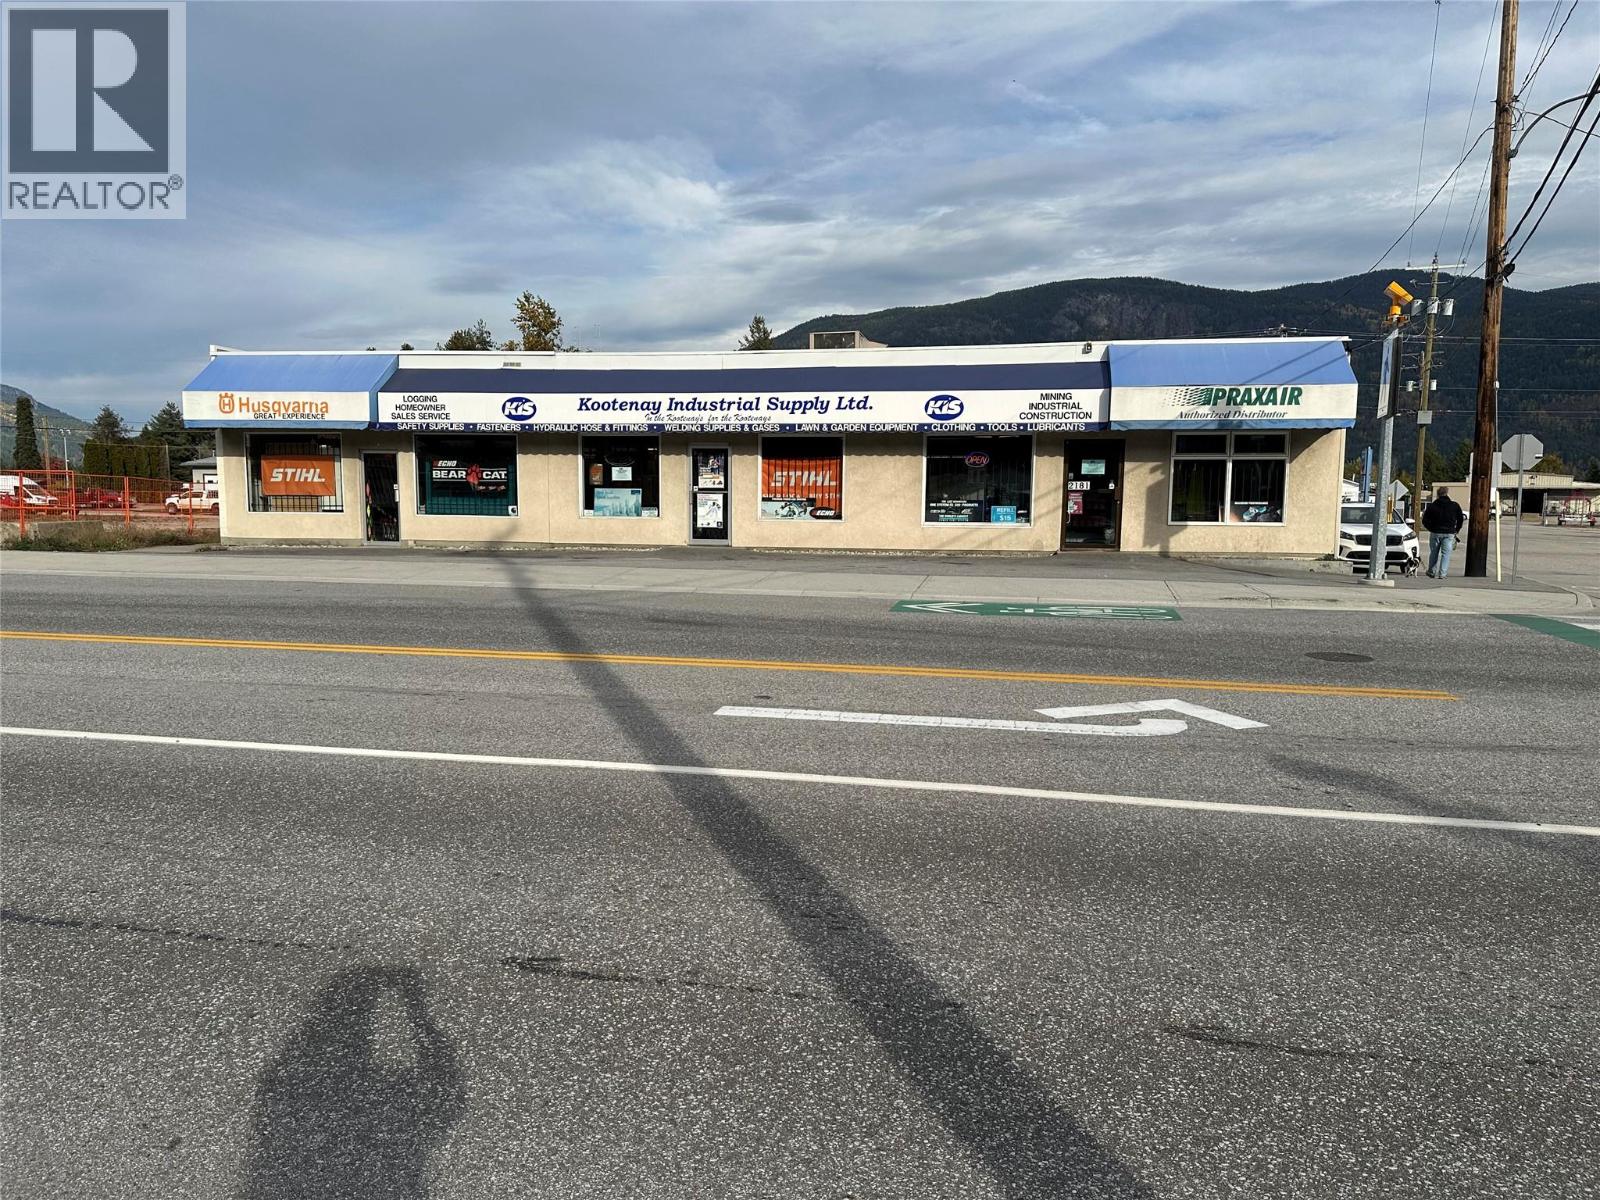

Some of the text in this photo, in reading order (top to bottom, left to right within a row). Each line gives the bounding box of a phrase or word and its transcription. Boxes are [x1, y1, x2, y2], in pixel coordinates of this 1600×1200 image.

[402, 395, 438, 403] LOGGING
[1040, 393, 1073, 401] MINING
[1211, 386, 1303, 406] PRAXAIR
[239, 397, 329, 416] Husqvarna
[577, 395, 873, 415] Kootenay Industrial Supply Ltd.
[1028, 402, 1083, 410] INDUSTRIAL
[391, 412, 450, 420] SALES SERVICE
[654, 413, 665, 421] the
[706, 413, 719, 424] for
[720, 413, 732, 421] the
[1019, 412, 1093, 420] CONSTRUCTION
[1176, 410, 1288, 419] Authorized Distributor
[477, 423, 521, 431] FASTENERS
[533, 424, 578, 432] HYDRAULIC
[580, 424, 602, 432] HOSE
[604, 424, 611, 432] &
[612, 424, 649, 432] FITTINGS
[664, 424, 701, 432] WELDING
[703, 424, 741, 432] SUPPLIES
[743, 424, 750, 432] &
[751, 424, 780, 432] GASES
[931, 423, 976, 431] CLOTHING
[987, 423, 1018, 431] TOOLS
[1027, 423, 1085, 431] LUBRICANTS
[965, 455, 988, 464] OPEN
[270, 468, 326, 482] STIHL
[432, 470, 507, 479] BEAR CAT
[770, 471, 837, 487] STIHL
[1068, 481, 1089, 490] 2181
